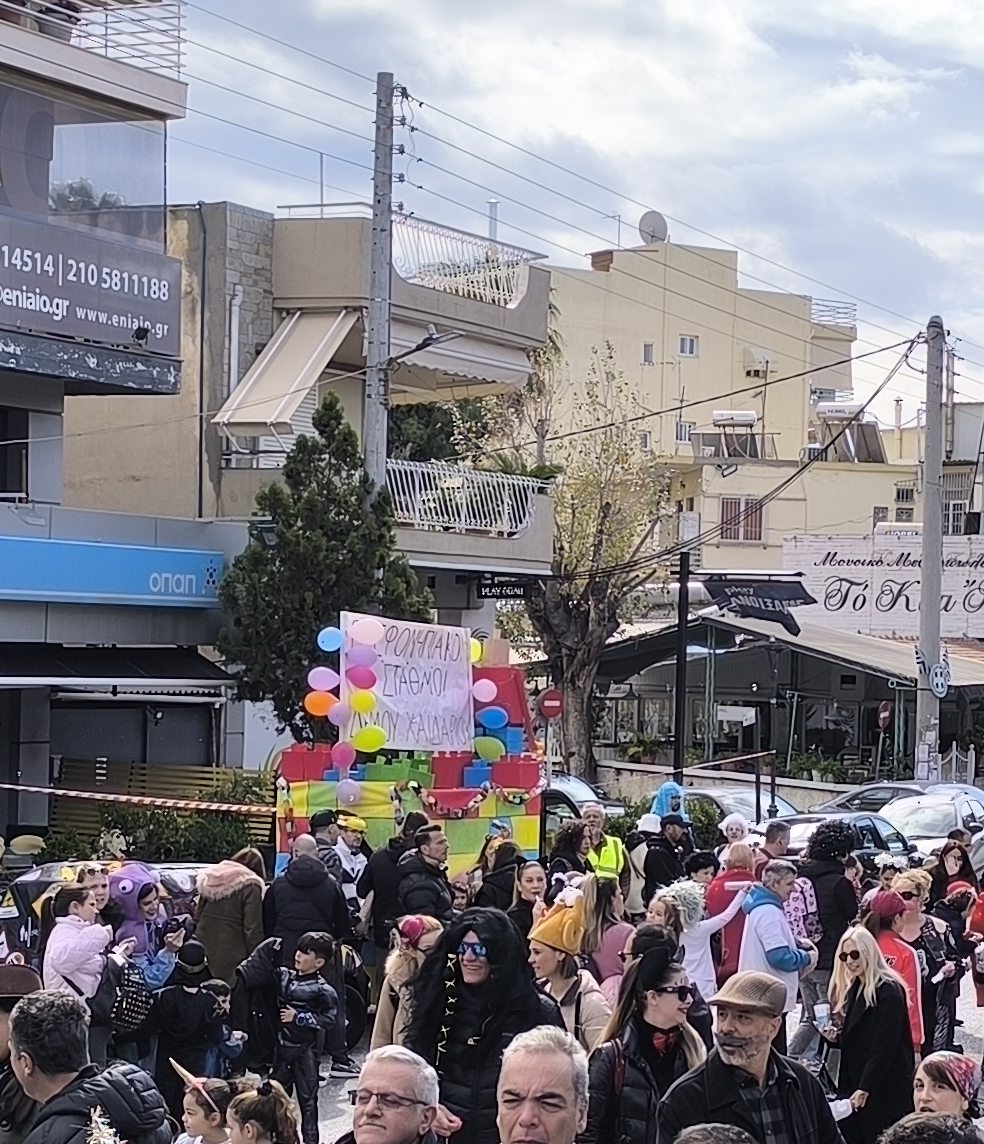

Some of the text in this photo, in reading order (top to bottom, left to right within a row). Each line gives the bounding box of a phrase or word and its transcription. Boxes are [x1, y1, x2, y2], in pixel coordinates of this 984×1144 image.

[66, 258, 98, 286] 210
[101, 266, 169, 301] 5811188
[0, 284, 169, 339] eniaio.gr www.eniaio.gr
